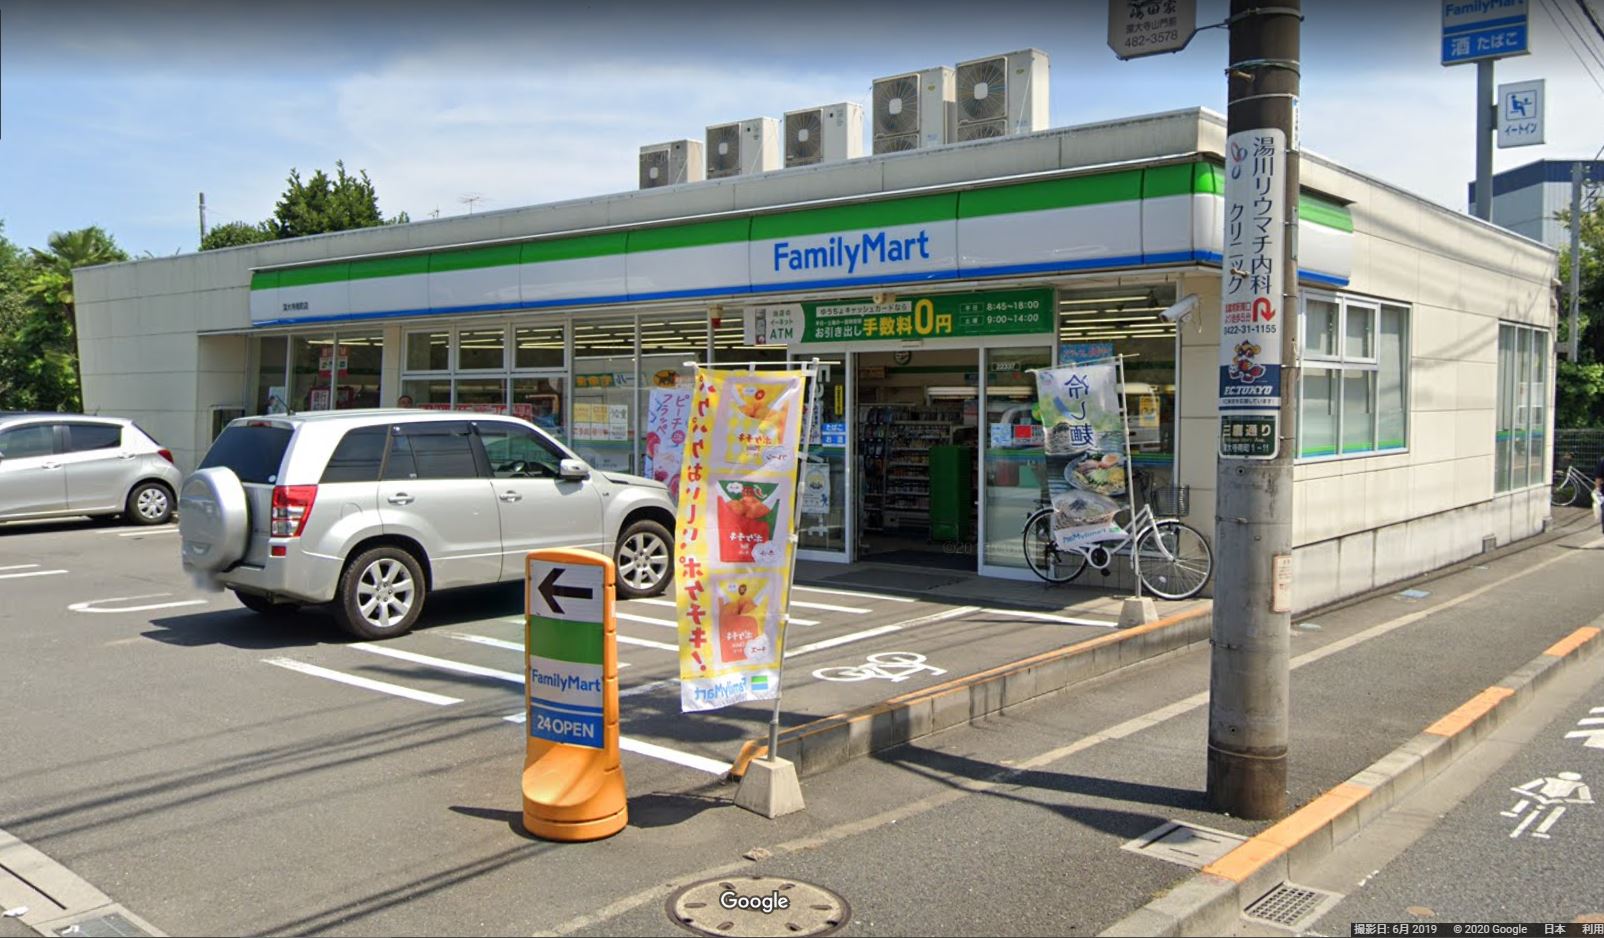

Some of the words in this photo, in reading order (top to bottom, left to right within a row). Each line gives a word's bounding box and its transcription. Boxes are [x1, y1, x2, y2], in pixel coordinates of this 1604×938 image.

[1124, 30, 1178, 48] 482-3578
[1451, 36, 1471, 56] 酒
[1477, 32, 1517, 50] たばこ
[1505, 123, 1537, 135] イートイン
[1250, 136, 1274, 294] 湯川リウマチ内科
[774, 230, 930, 273] FamilyMart
[1229, 203, 1244, 295] クリニック
[770, 328, 793, 340] ATM
[656, 394, 673, 434] フラッペ
[671, 393, 690, 430] ピーチ
[532, 669, 601, 693] FamilyMart
